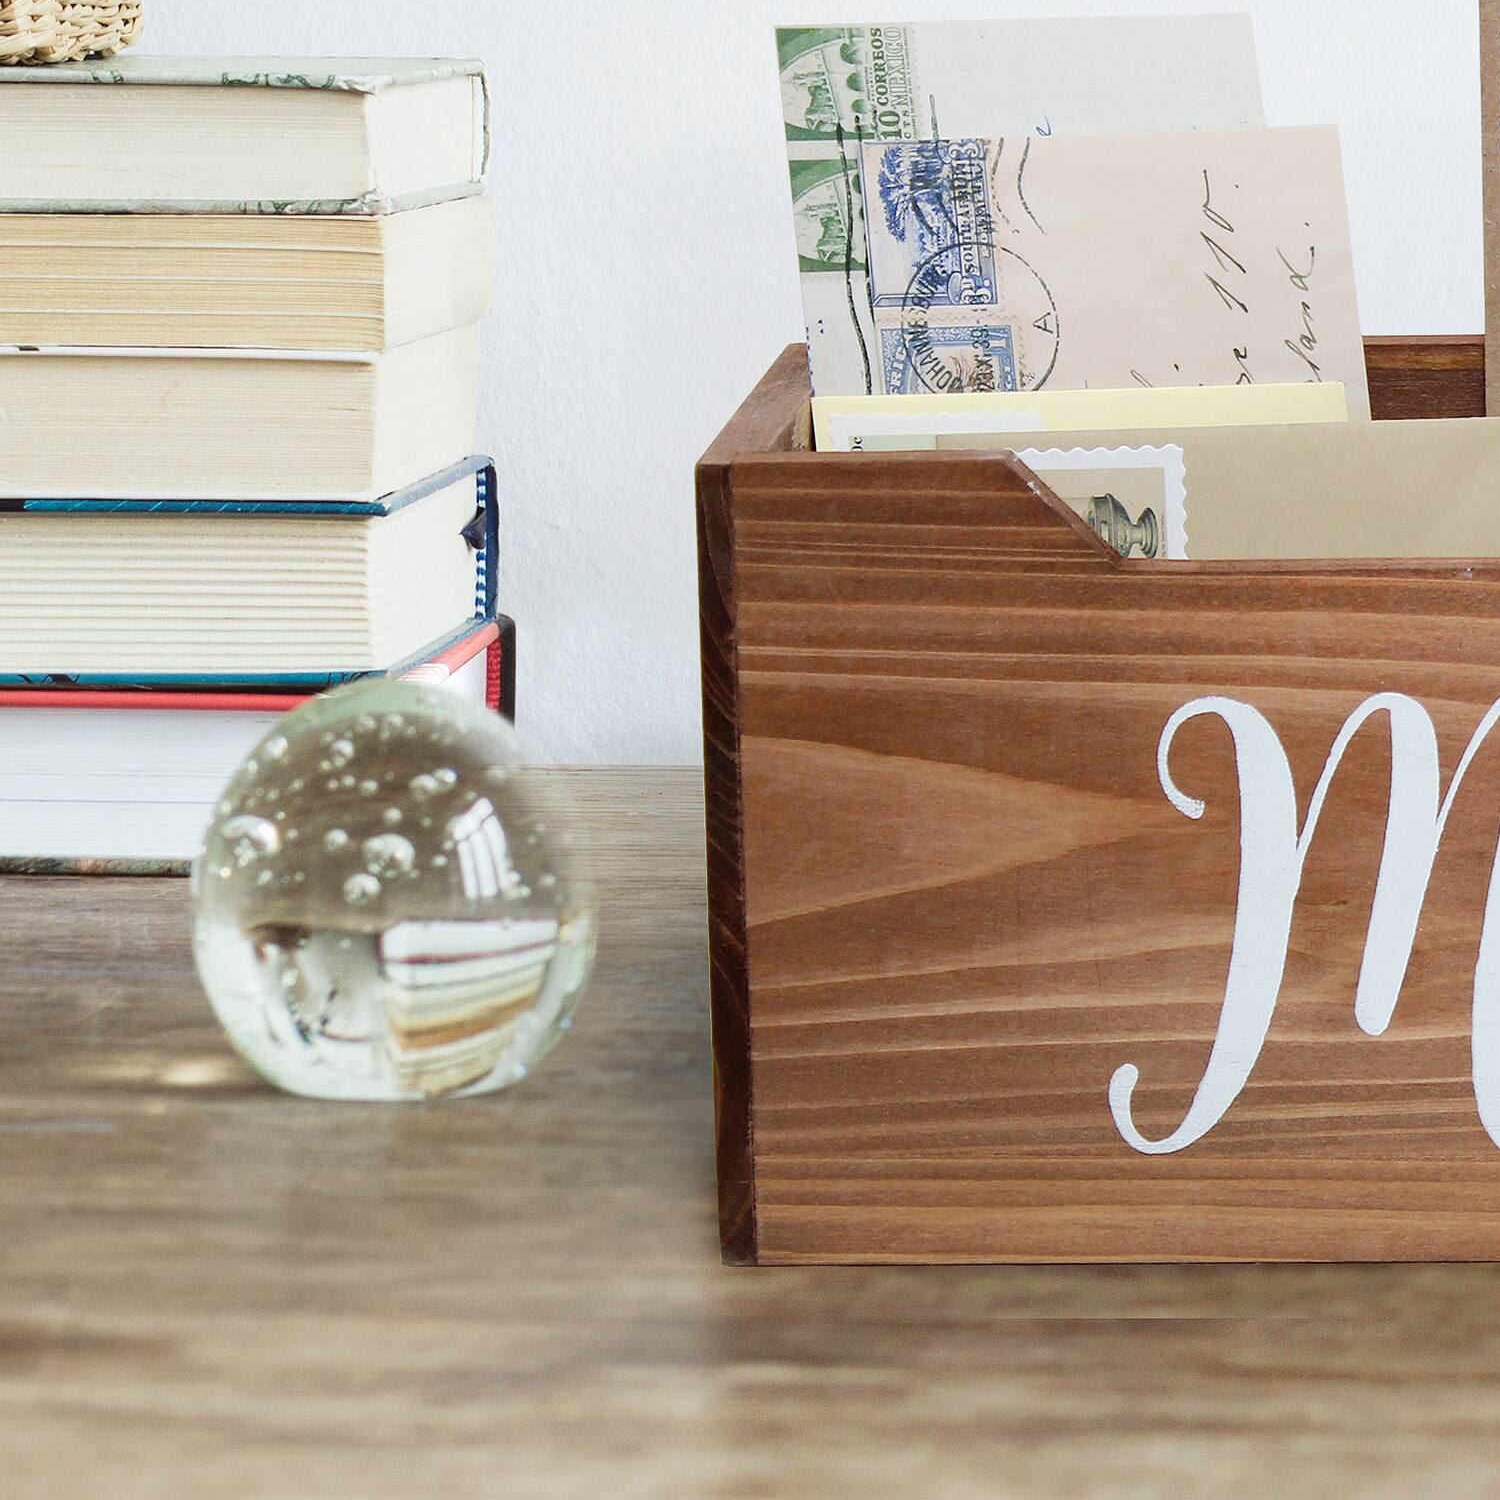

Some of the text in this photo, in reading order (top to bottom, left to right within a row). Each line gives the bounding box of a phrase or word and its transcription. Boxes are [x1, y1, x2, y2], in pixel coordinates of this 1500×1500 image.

[869, 26, 889, 107] CORREOS
[883, 25, 909, 107] MEXICO
[877, 110, 902, 140] 10
